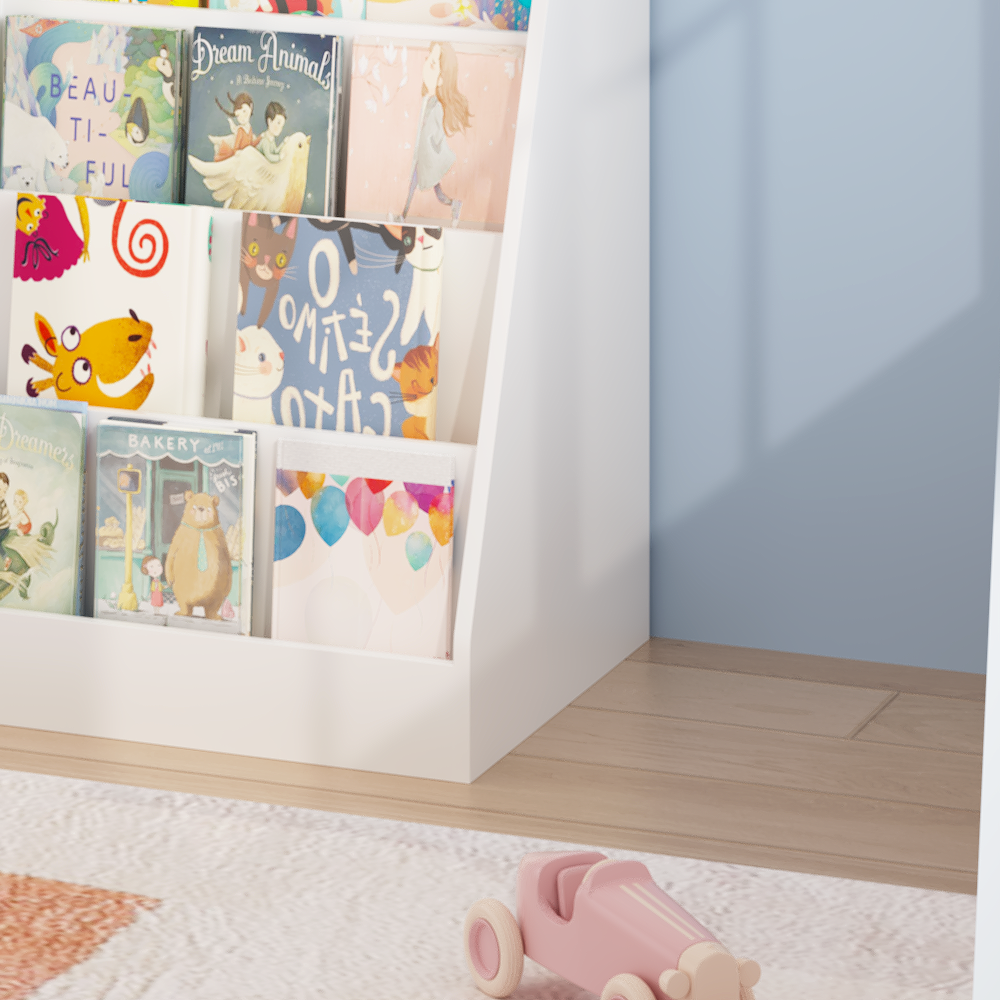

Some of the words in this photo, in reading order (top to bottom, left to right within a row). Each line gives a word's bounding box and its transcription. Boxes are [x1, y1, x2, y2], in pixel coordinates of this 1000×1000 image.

[190, 31, 255, 82] Dream
[257, 31, 332, 91] Animals
[50, 73, 132, 104] BEAU-
[69, 116, 107, 144] TI-
[85, 159, 131, 188] FUL
[128, 433, 200, 453] BAKERY
